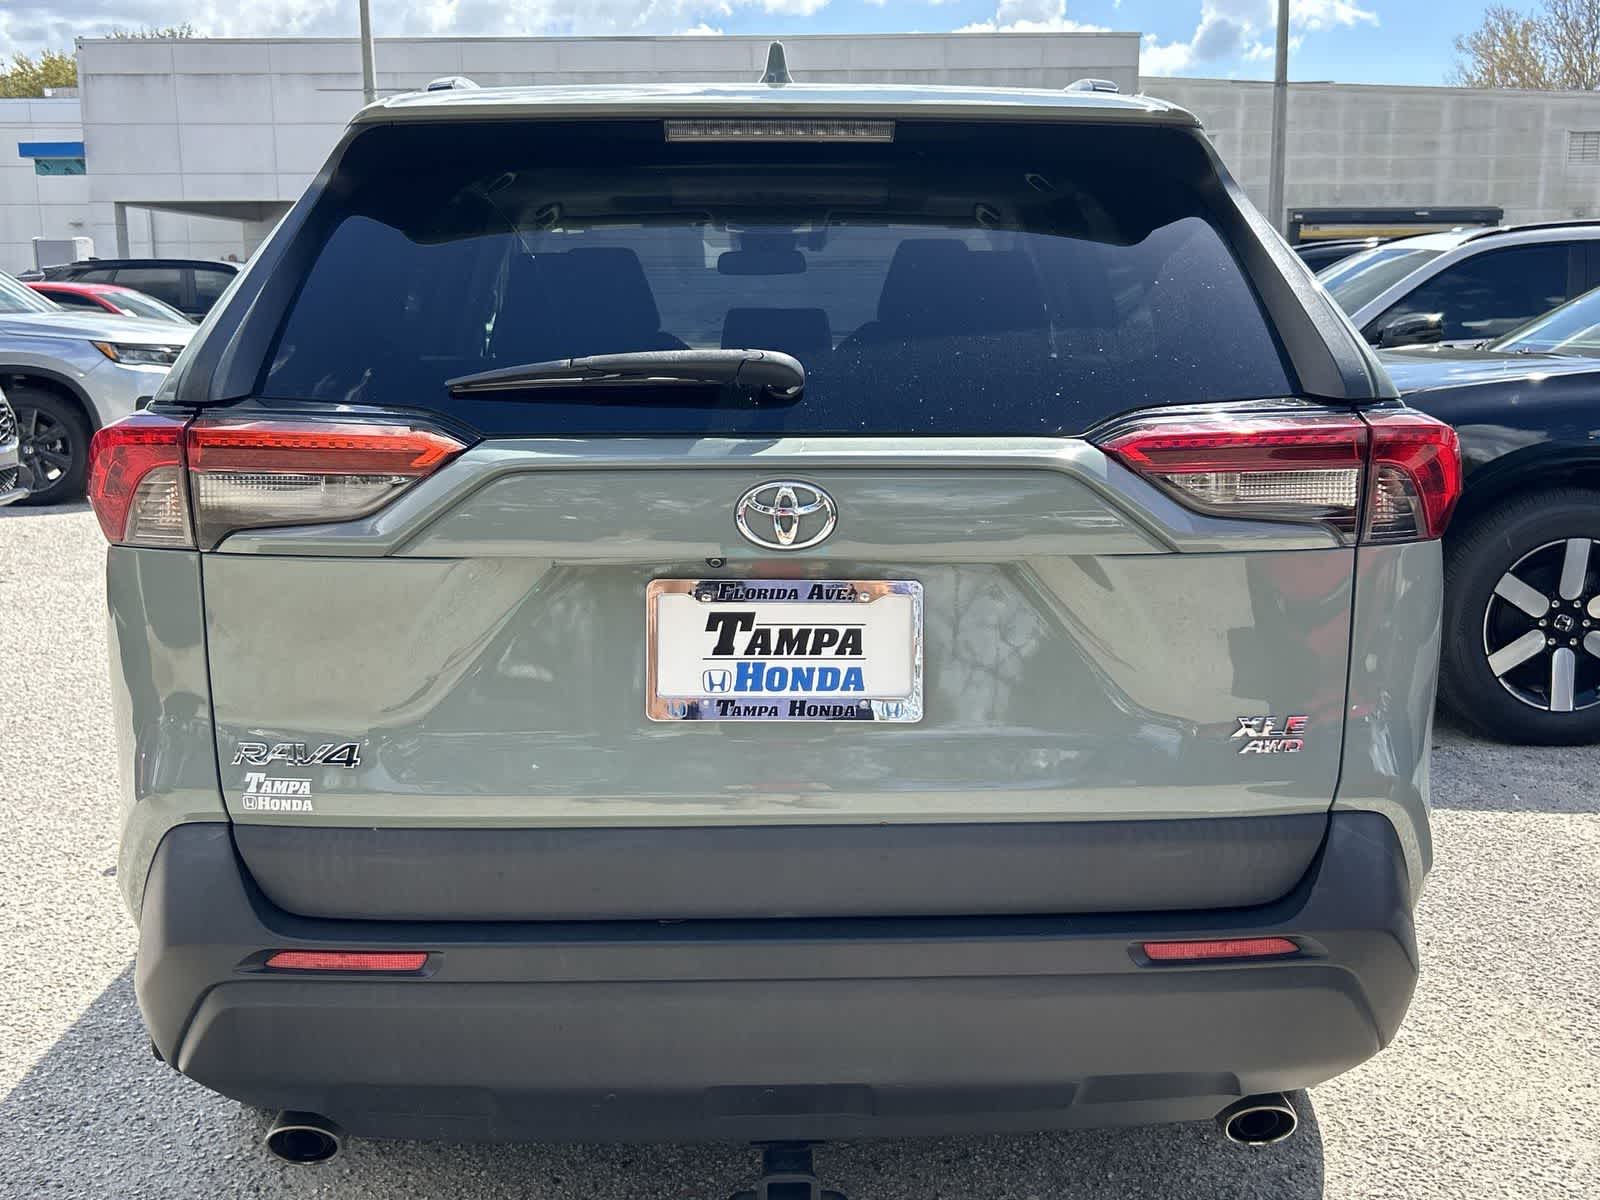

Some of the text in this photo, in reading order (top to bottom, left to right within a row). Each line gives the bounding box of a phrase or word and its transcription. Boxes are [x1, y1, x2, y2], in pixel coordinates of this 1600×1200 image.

[717, 582, 799, 601] FLORIDA
[704, 611, 863, 656] TAMPA
[734, 662, 865, 692] HONDA
[716, 699, 856, 717] TAMPA HONDA
[1230, 715, 1309, 737] XLE
[231, 741, 361, 769] RAV4
[1239, 738, 1305, 754] AWD
[244, 772, 311, 795] TAMPA
[257, 796, 313, 811] HONDA
